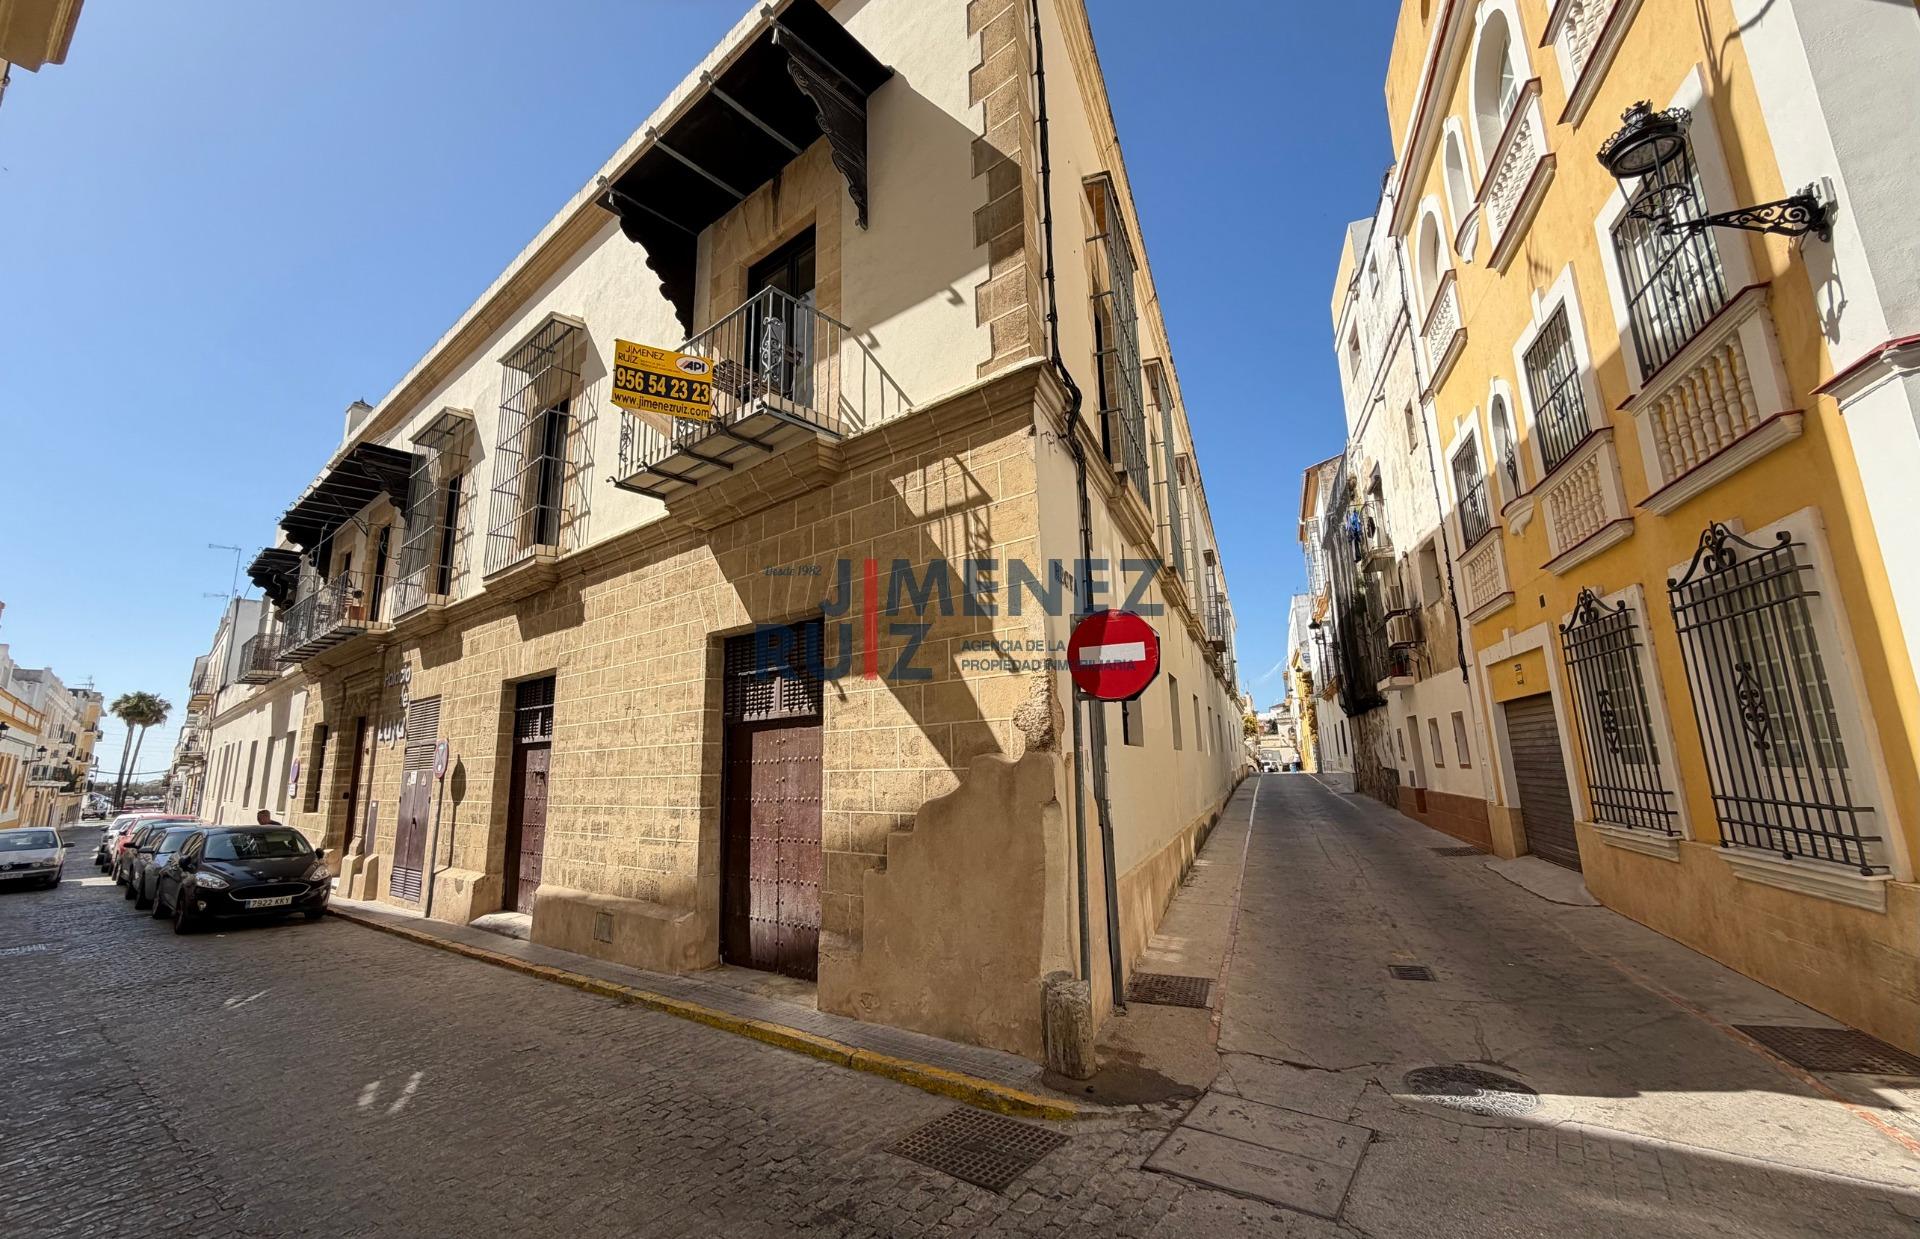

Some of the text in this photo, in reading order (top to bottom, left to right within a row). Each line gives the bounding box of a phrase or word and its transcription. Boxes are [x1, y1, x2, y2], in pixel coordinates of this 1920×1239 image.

[618, 352, 638, 365] RUIZ
[625, 345, 664, 361] JIMENEZ
[683, 361, 705, 373] API
[616, 367, 710, 403] 956 54 23 23
[614, 392, 710, 417] www.jimenezruiz.com
